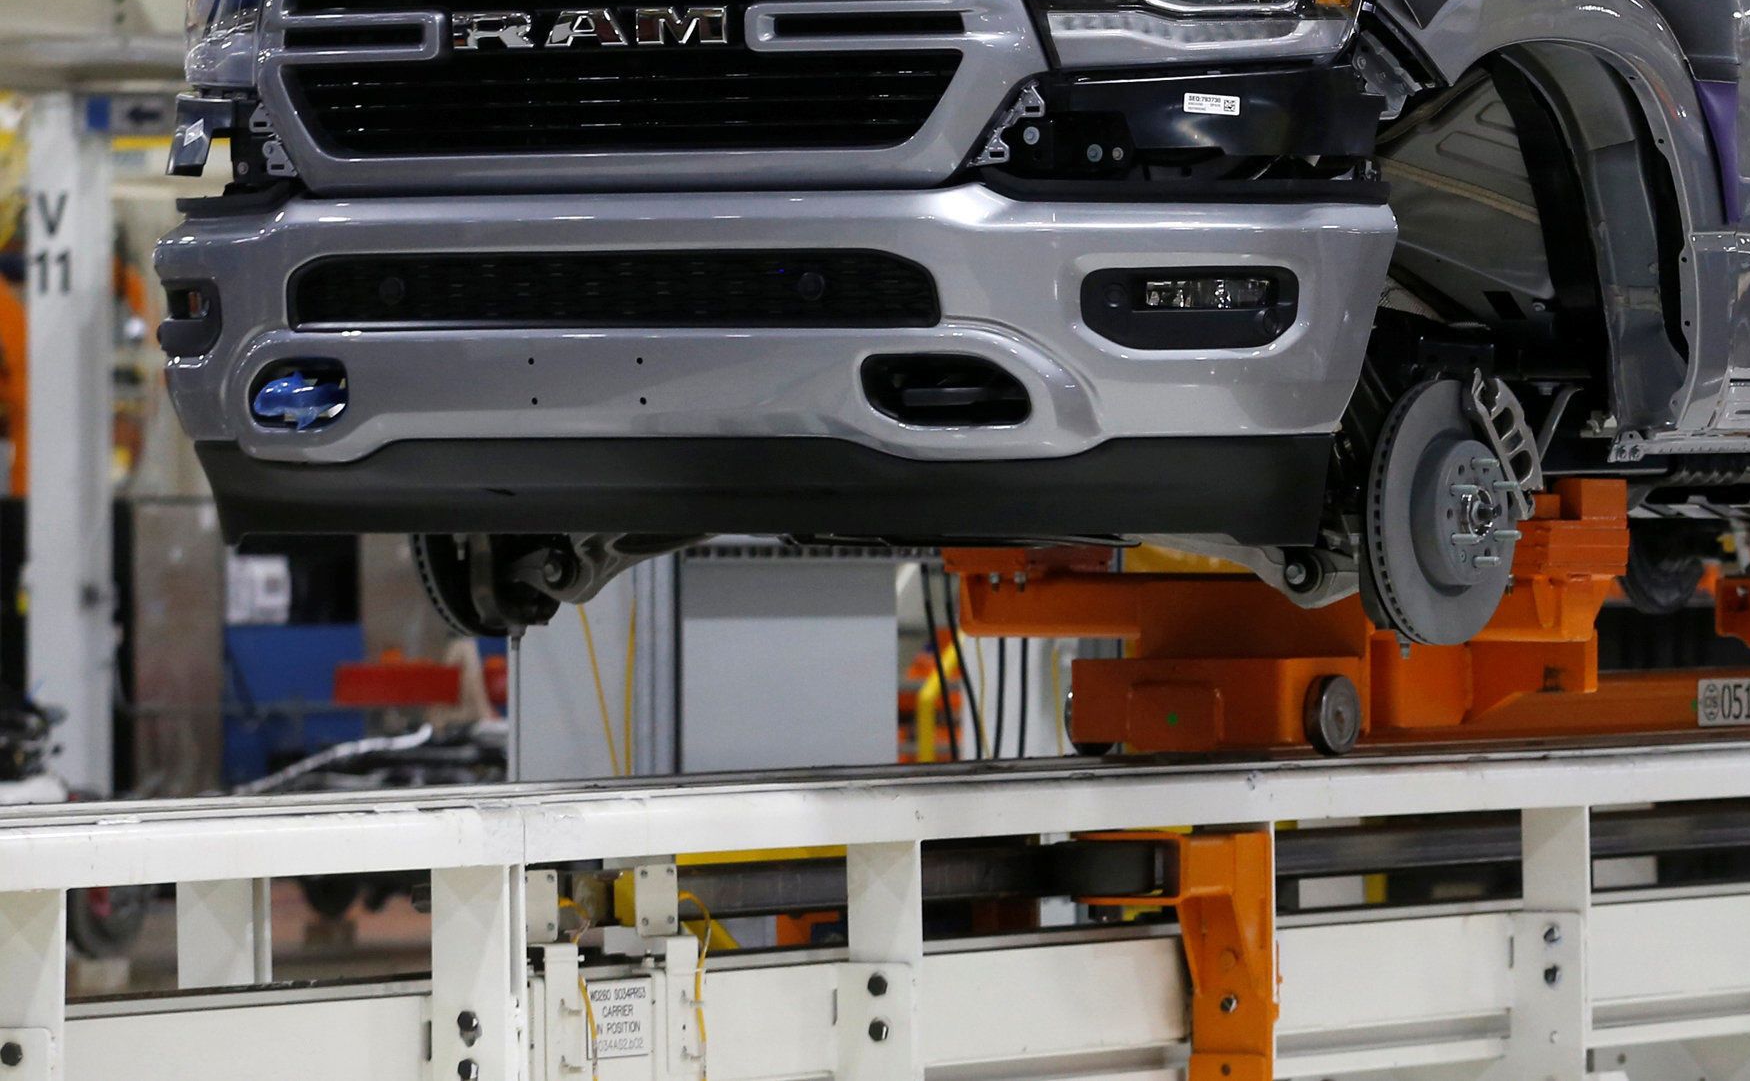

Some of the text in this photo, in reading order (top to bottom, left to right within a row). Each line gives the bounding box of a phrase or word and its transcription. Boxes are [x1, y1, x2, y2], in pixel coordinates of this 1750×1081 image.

[451, 6, 728, 49] RAM
[36, 190, 67, 235] V
[34, 247, 71, 295] 11
[602, 1003, 634, 1018] CARRIER
[606, 1020, 641, 1035] POSITION
